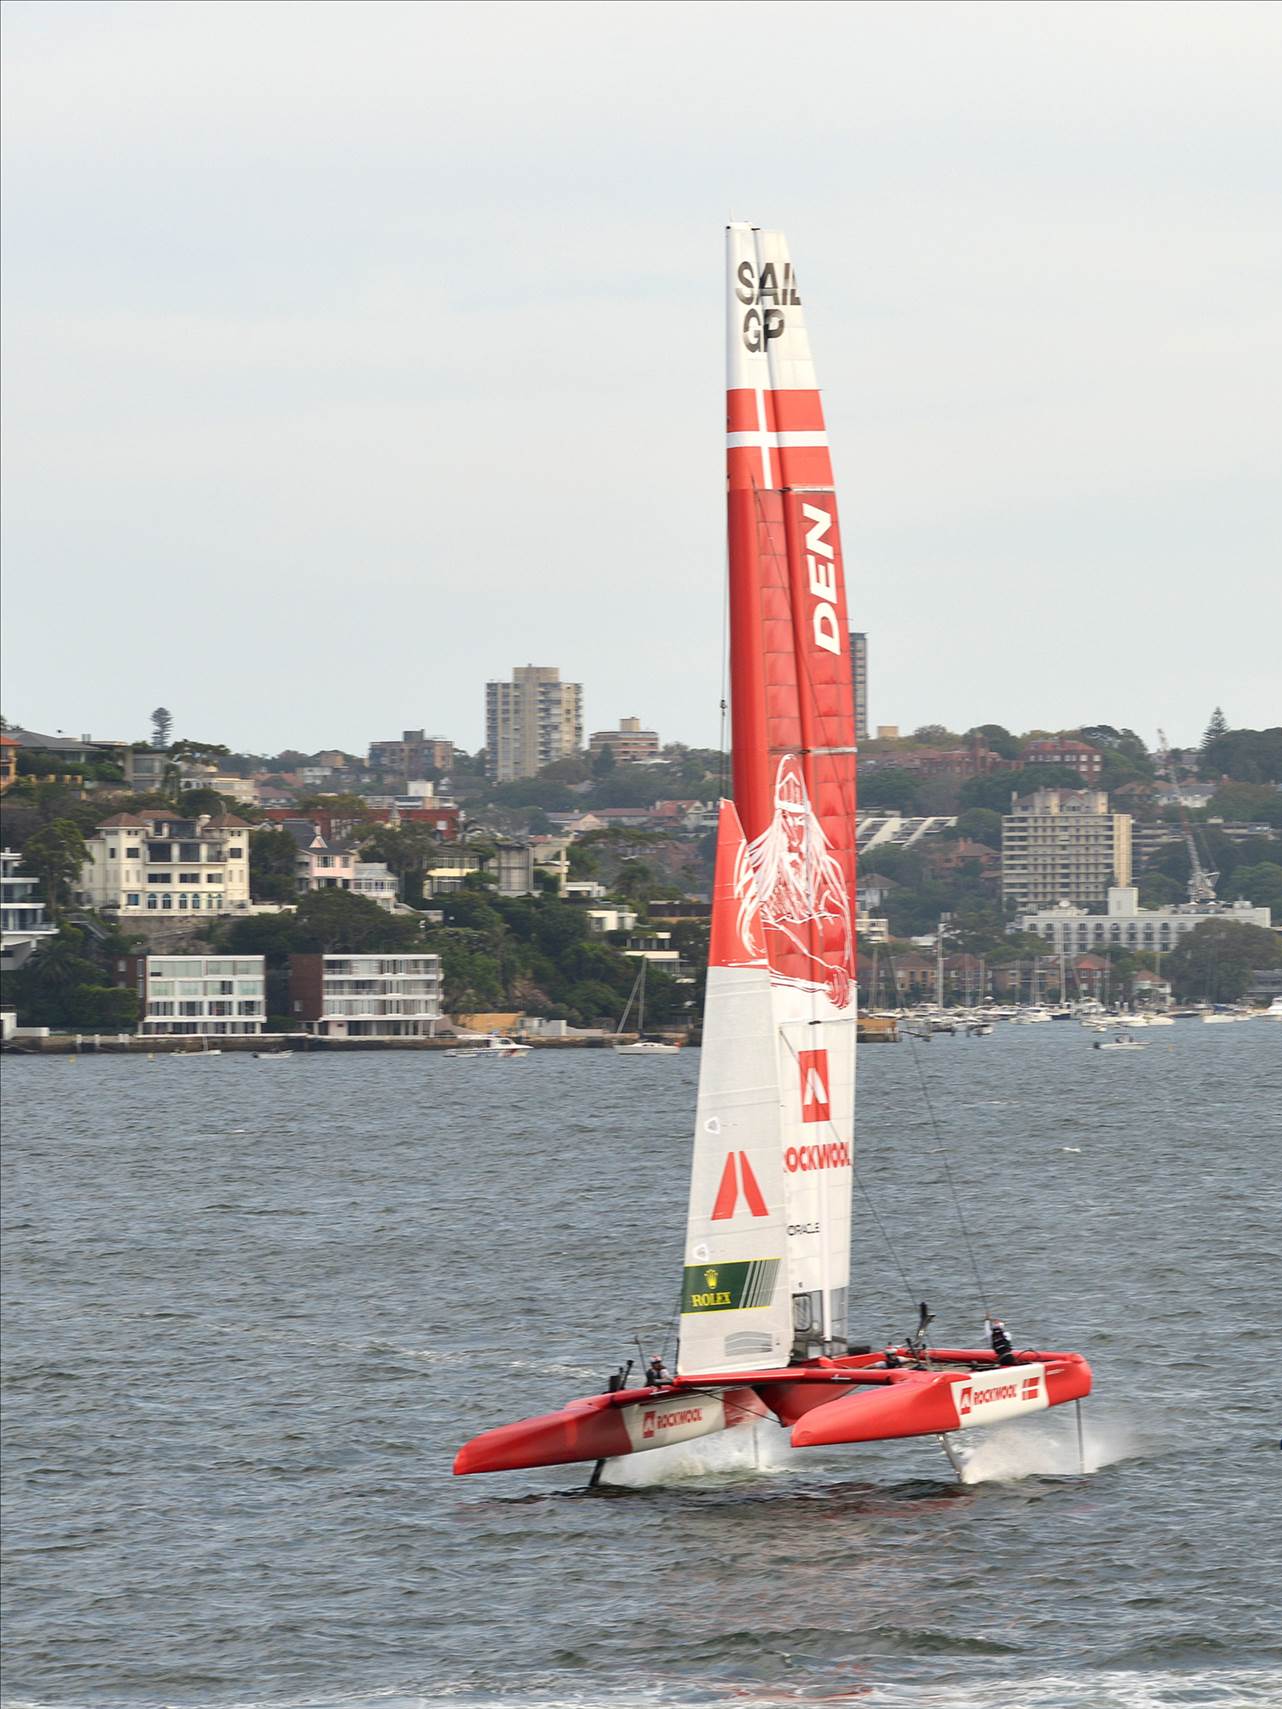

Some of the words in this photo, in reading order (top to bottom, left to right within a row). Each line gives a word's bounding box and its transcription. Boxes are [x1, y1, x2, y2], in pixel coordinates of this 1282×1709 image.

[736, 261, 802, 305] SAIL
[743, 308, 785, 352] GP
[802, 503, 841, 655] DEN
[784, 1142, 852, 1172] OCKWOOL
[690, 1291, 732, 1308] ROLEX
[974, 1384, 1017, 1405] ROCKWOOL
[657, 1408, 703, 1429] ROCKWOOL
